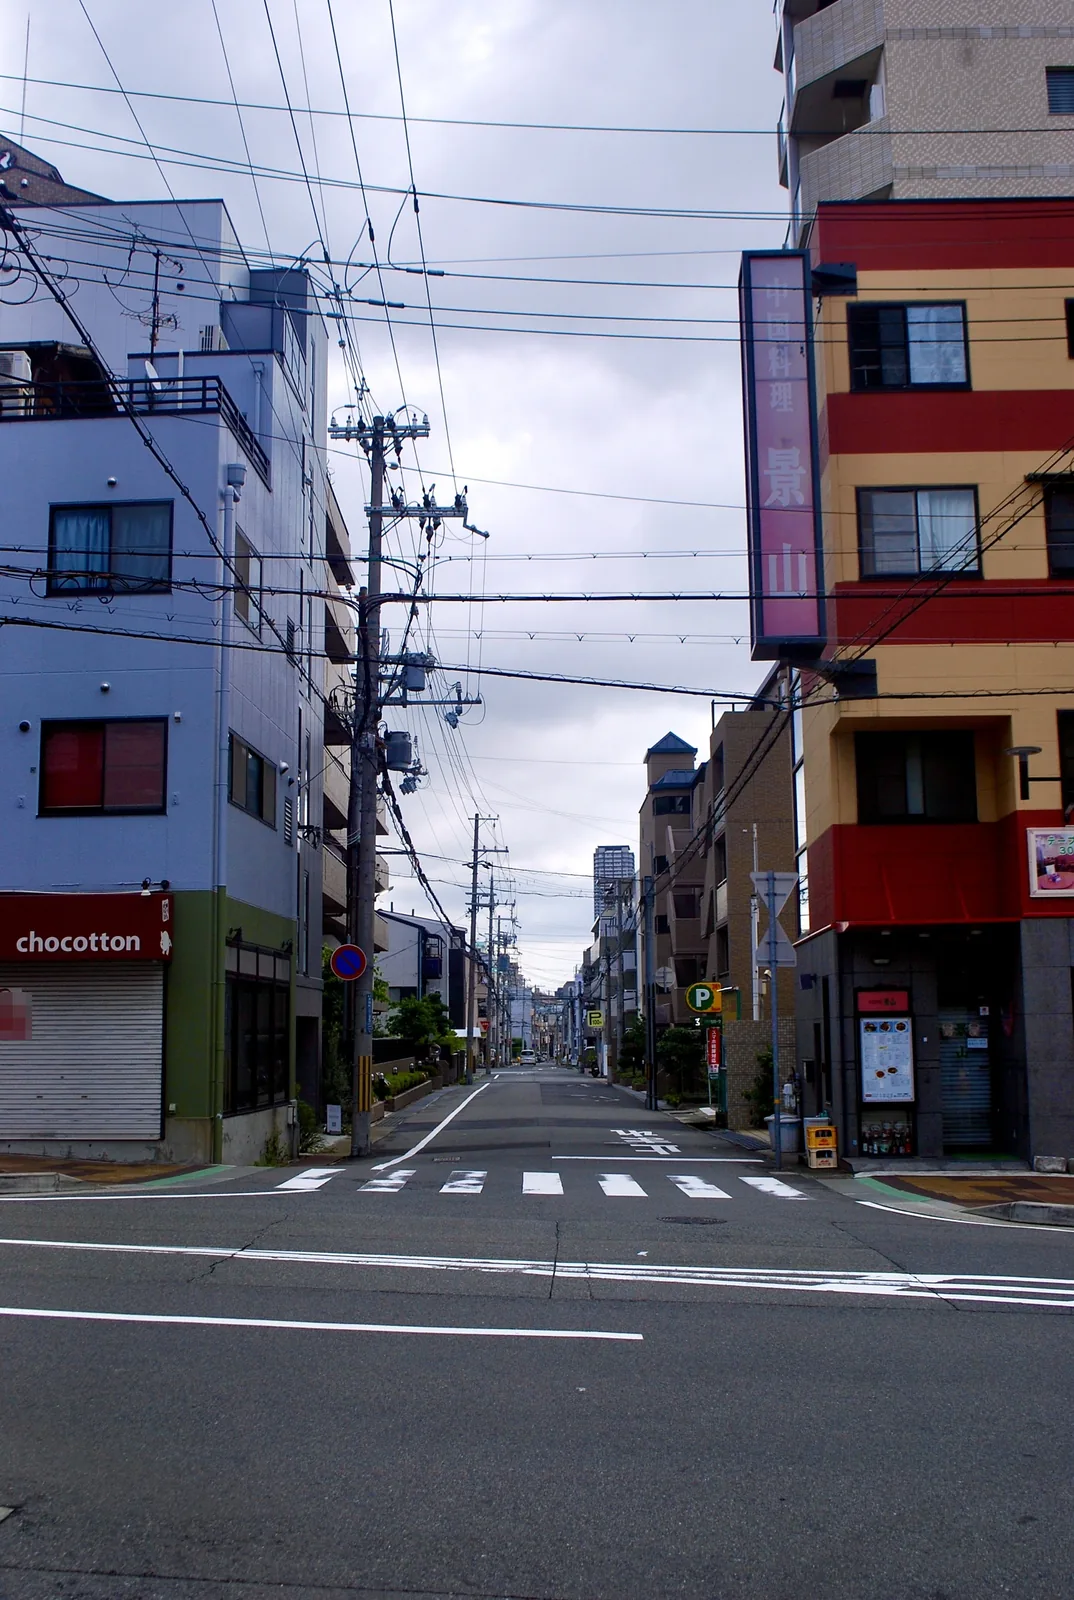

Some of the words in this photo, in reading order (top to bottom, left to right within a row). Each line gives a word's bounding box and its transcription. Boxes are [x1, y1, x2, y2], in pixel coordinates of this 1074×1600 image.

[766, 277, 794, 412] 中国料理
[764, 447, 808, 597] 景山
[16, 931, 140, 952] chocotton
[695, 988, 710, 1008] P
[589, 1012, 602, 1025] P
